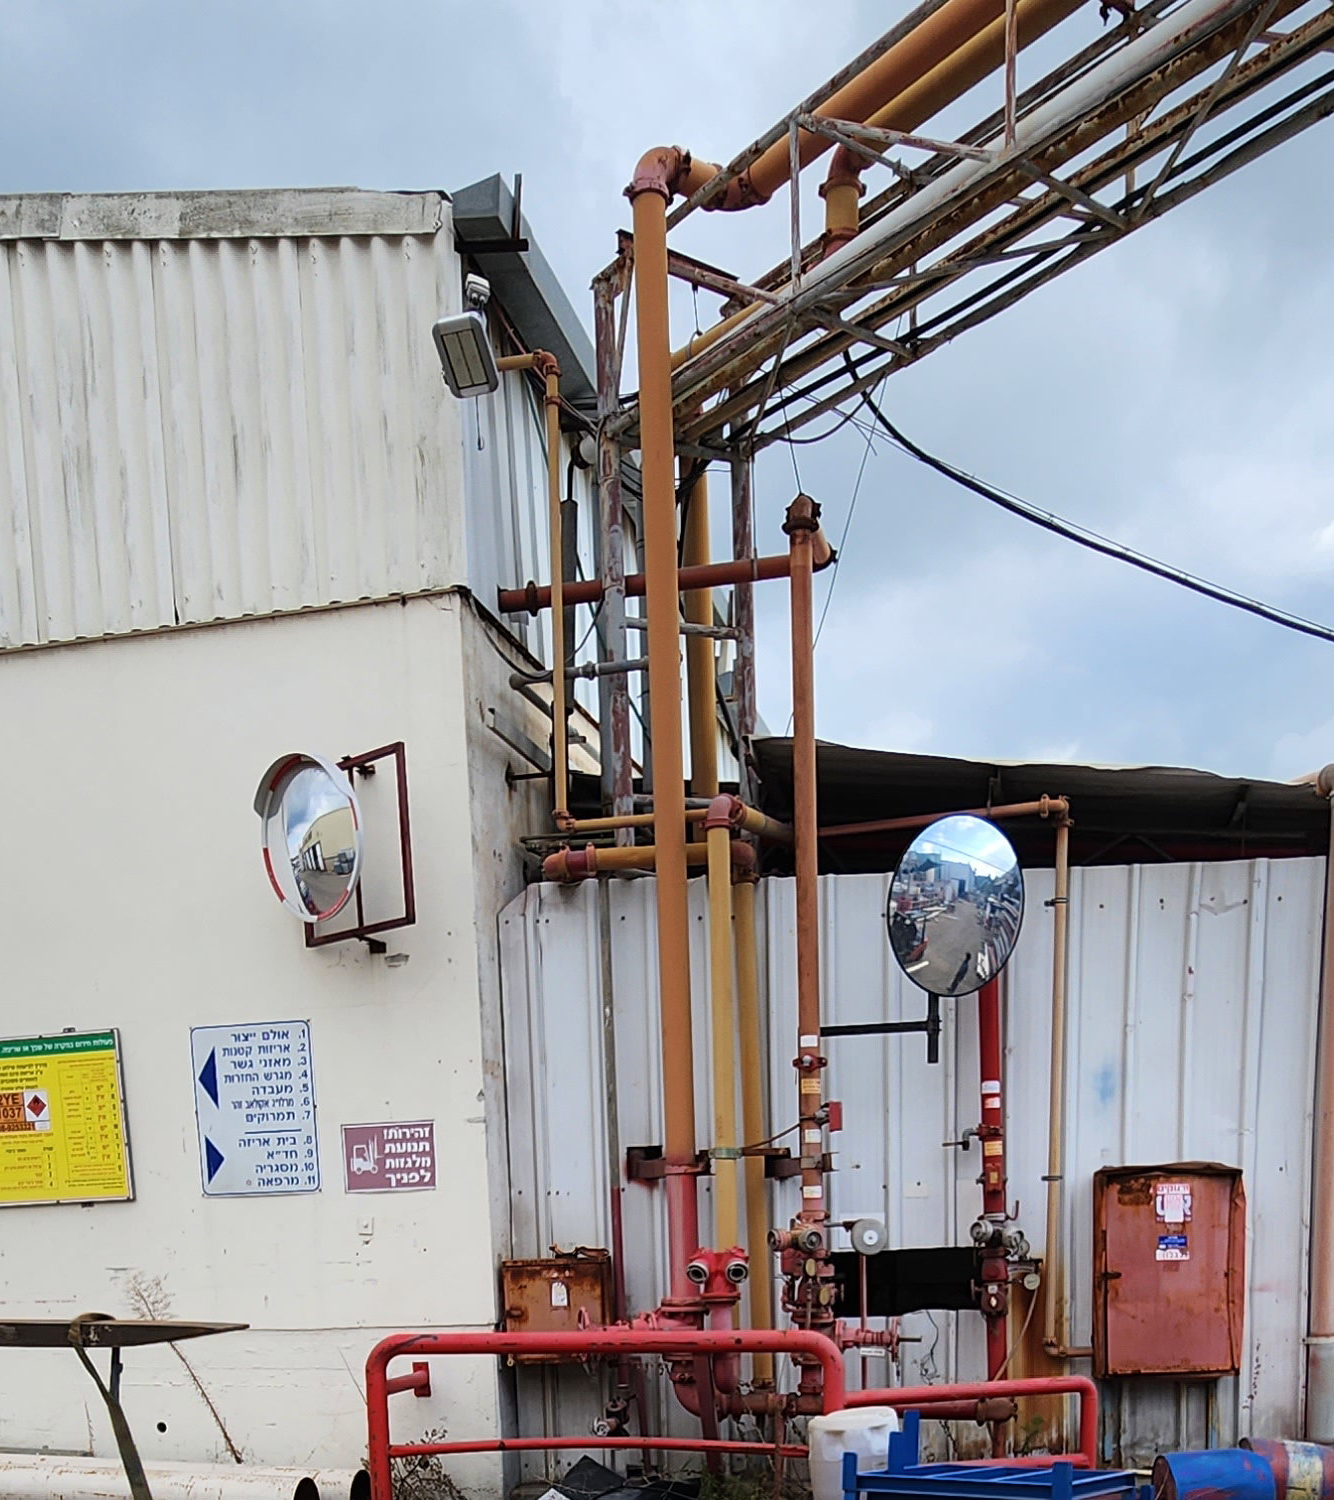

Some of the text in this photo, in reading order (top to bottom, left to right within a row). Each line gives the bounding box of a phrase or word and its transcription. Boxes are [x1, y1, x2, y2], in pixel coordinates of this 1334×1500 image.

[231, 1032, 256, 1042] ייצור
[262, 1029, 290, 1041] אולם
[222, 1045, 252, 1057] קטנות
[257, 1043, 291, 1055] אריזות
[230, 1060, 253, 1069] גשר
[259, 1057, 291, 1068] מאזני
[224, 1072, 259, 1084] החזרות
[264, 1070, 292, 1081] מגרש
[252, 1084, 293, 1095] מעבדה
[245, 1110, 296, 1124] תמרוקים
[383, 1126, 430, 1140] זהירות!
[238, 1137, 270, 1148] אריזה
[276, 1136, 297, 1146] בית
[384, 1141, 430, 1153] תנועת
[385, 1154, 431, 1169] מלגזות
[255, 1163, 299, 1174] מסגריה
[258, 1176, 300, 1187] מרפאה
[385, 1169, 431, 1187] לפניך
